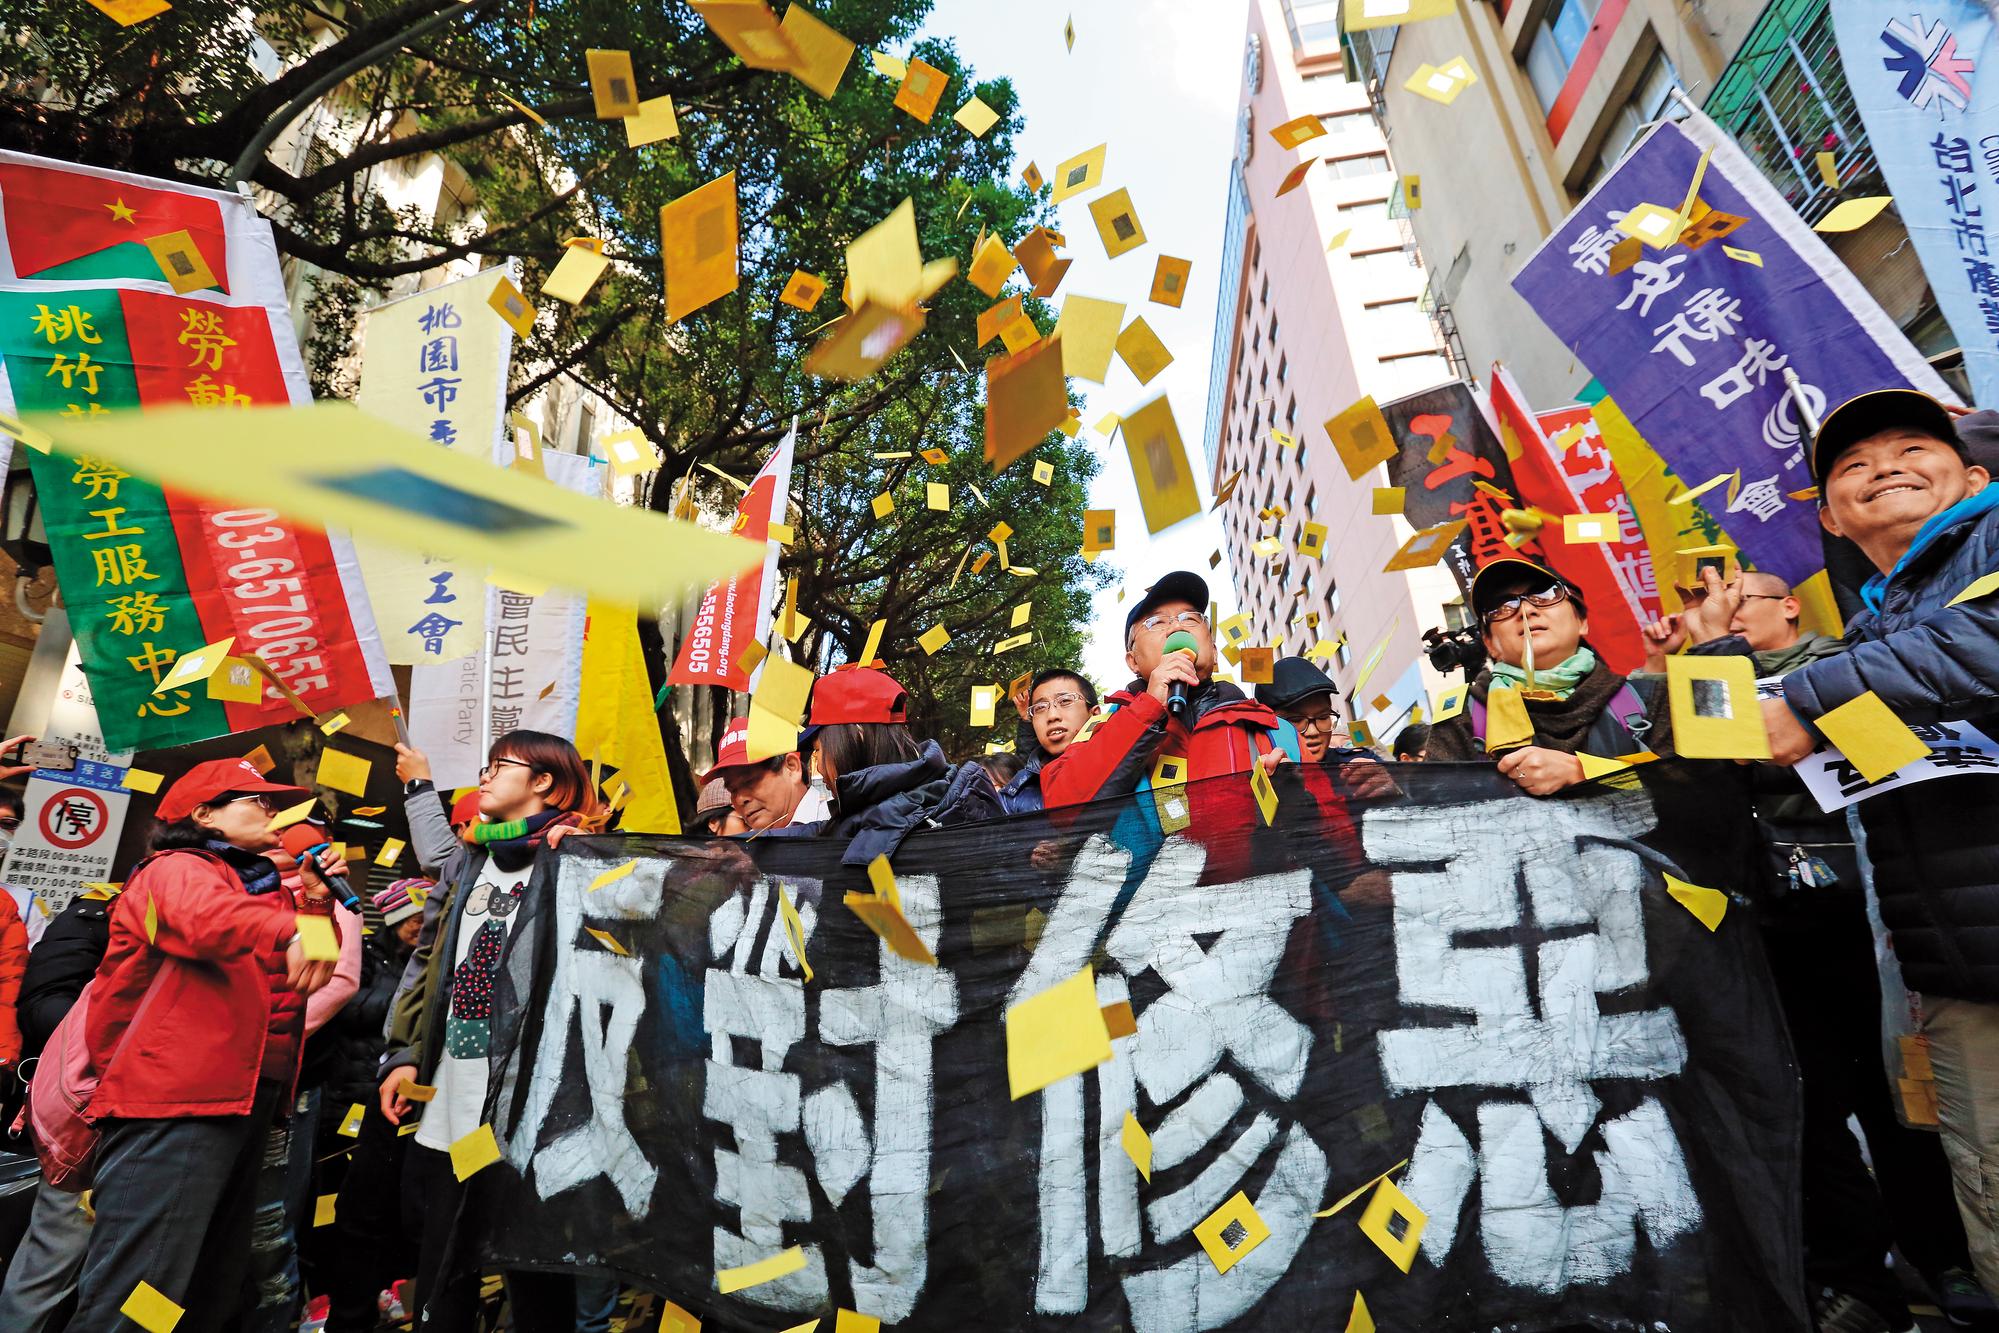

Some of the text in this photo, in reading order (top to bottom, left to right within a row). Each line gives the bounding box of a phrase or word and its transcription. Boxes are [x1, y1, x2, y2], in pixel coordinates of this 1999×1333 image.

[29, 303, 191, 719] 桃竹勞工服務中心
[209, 506, 332, 704] 03-6570655
[715, 573, 738, 677] ww.laodongdang.org
[453, 698, 478, 746] Party
[36, 769, 73, 782] Children
[56, 800, 95, 836] 停
[507, 797, 1704, 1332] 反對修惡
